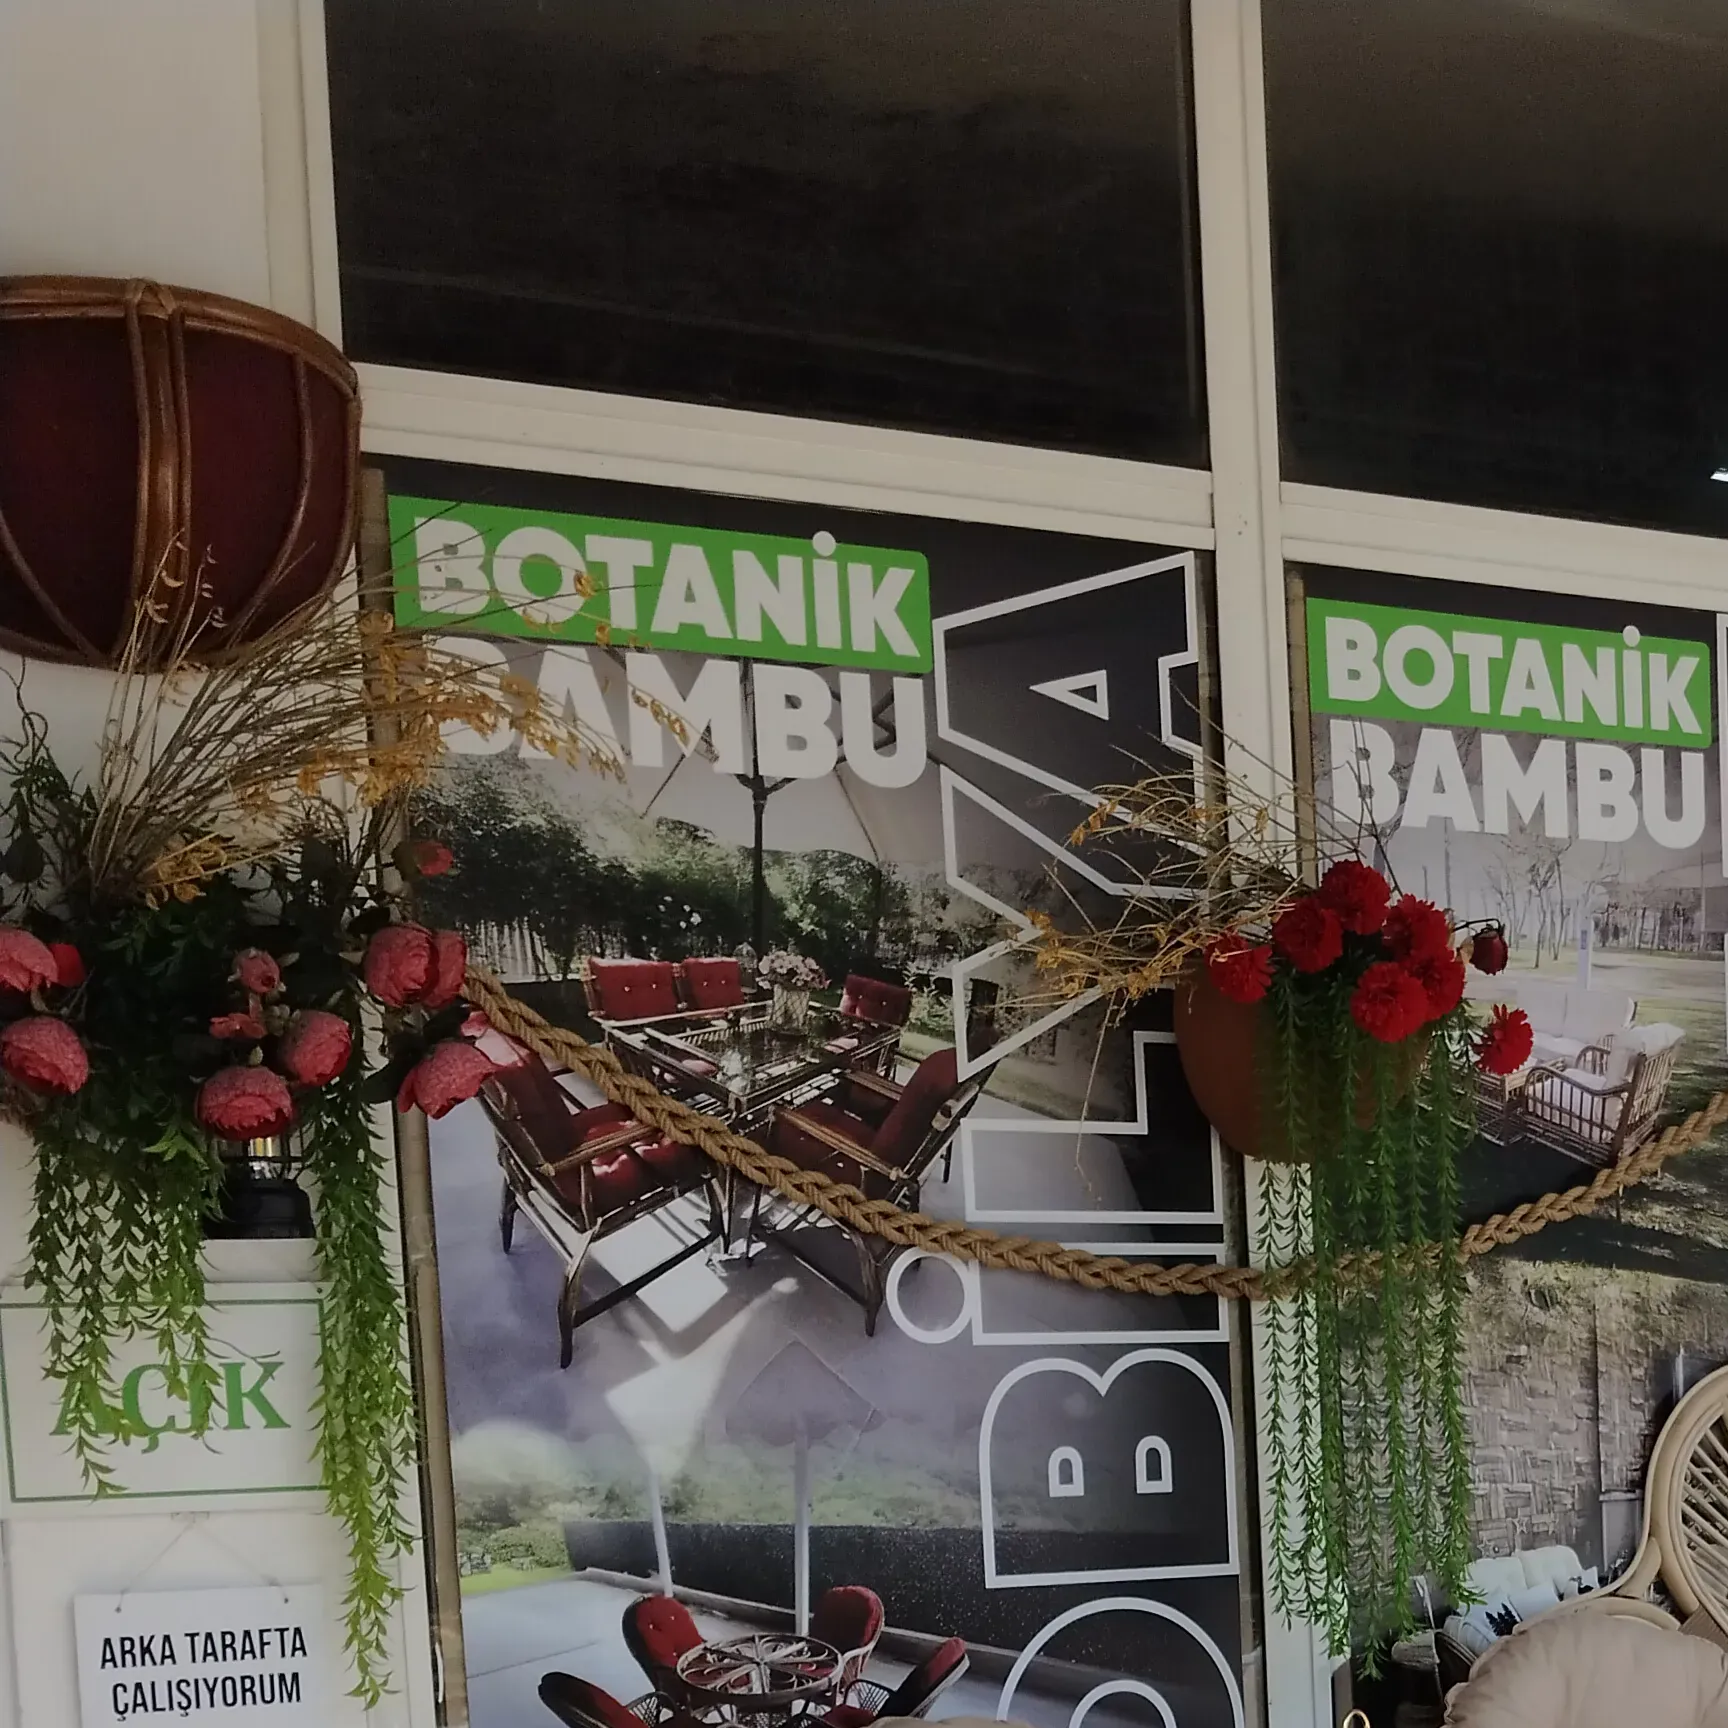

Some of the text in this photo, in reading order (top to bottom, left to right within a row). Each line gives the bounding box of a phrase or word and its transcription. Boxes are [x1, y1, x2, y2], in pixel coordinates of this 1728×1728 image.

[413, 516, 920, 659] BOTANİK
[1325, 616, 1702, 736] BOTANİK
[1328, 719, 1706, 850] BAMBU
[101, 1626, 308, 1670] ARKA TARAFTA
[112, 1671, 302, 1722] ÇALIŞIYORUM
